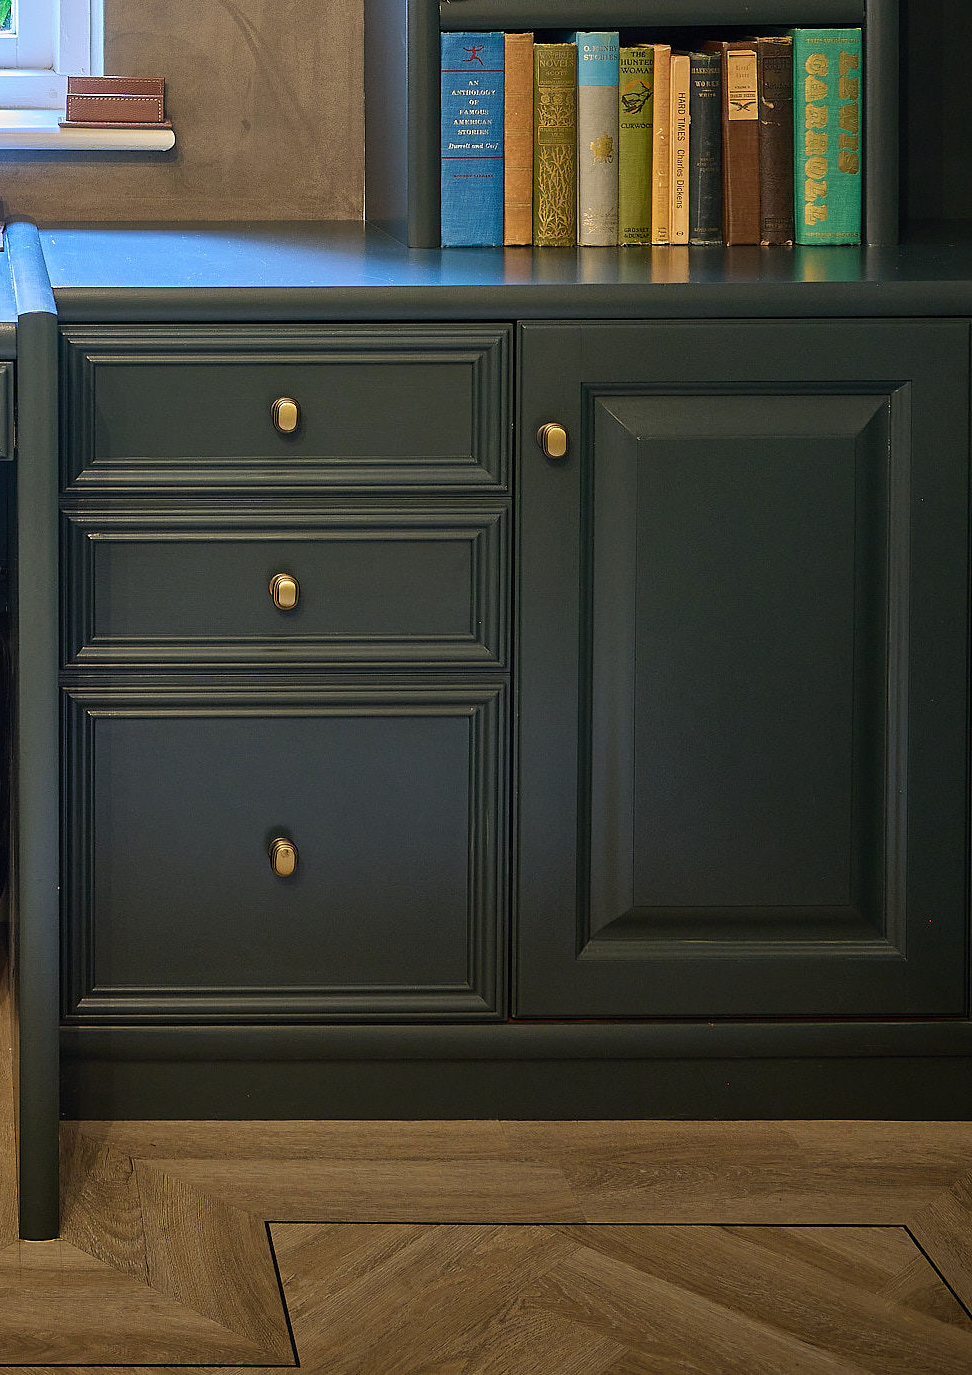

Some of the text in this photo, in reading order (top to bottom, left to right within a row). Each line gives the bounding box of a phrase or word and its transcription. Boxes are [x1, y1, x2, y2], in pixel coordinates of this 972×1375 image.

[583, 44, 619, 53] O. HENRY
[583, 53, 619, 61] STORIES
[677, 91, 687, 142] HARD TIMES
[803, 52, 829, 227] CARROLL
[837, 49, 860, 175] LEWIS
[676, 149, 686, 210] Charles Dickens
